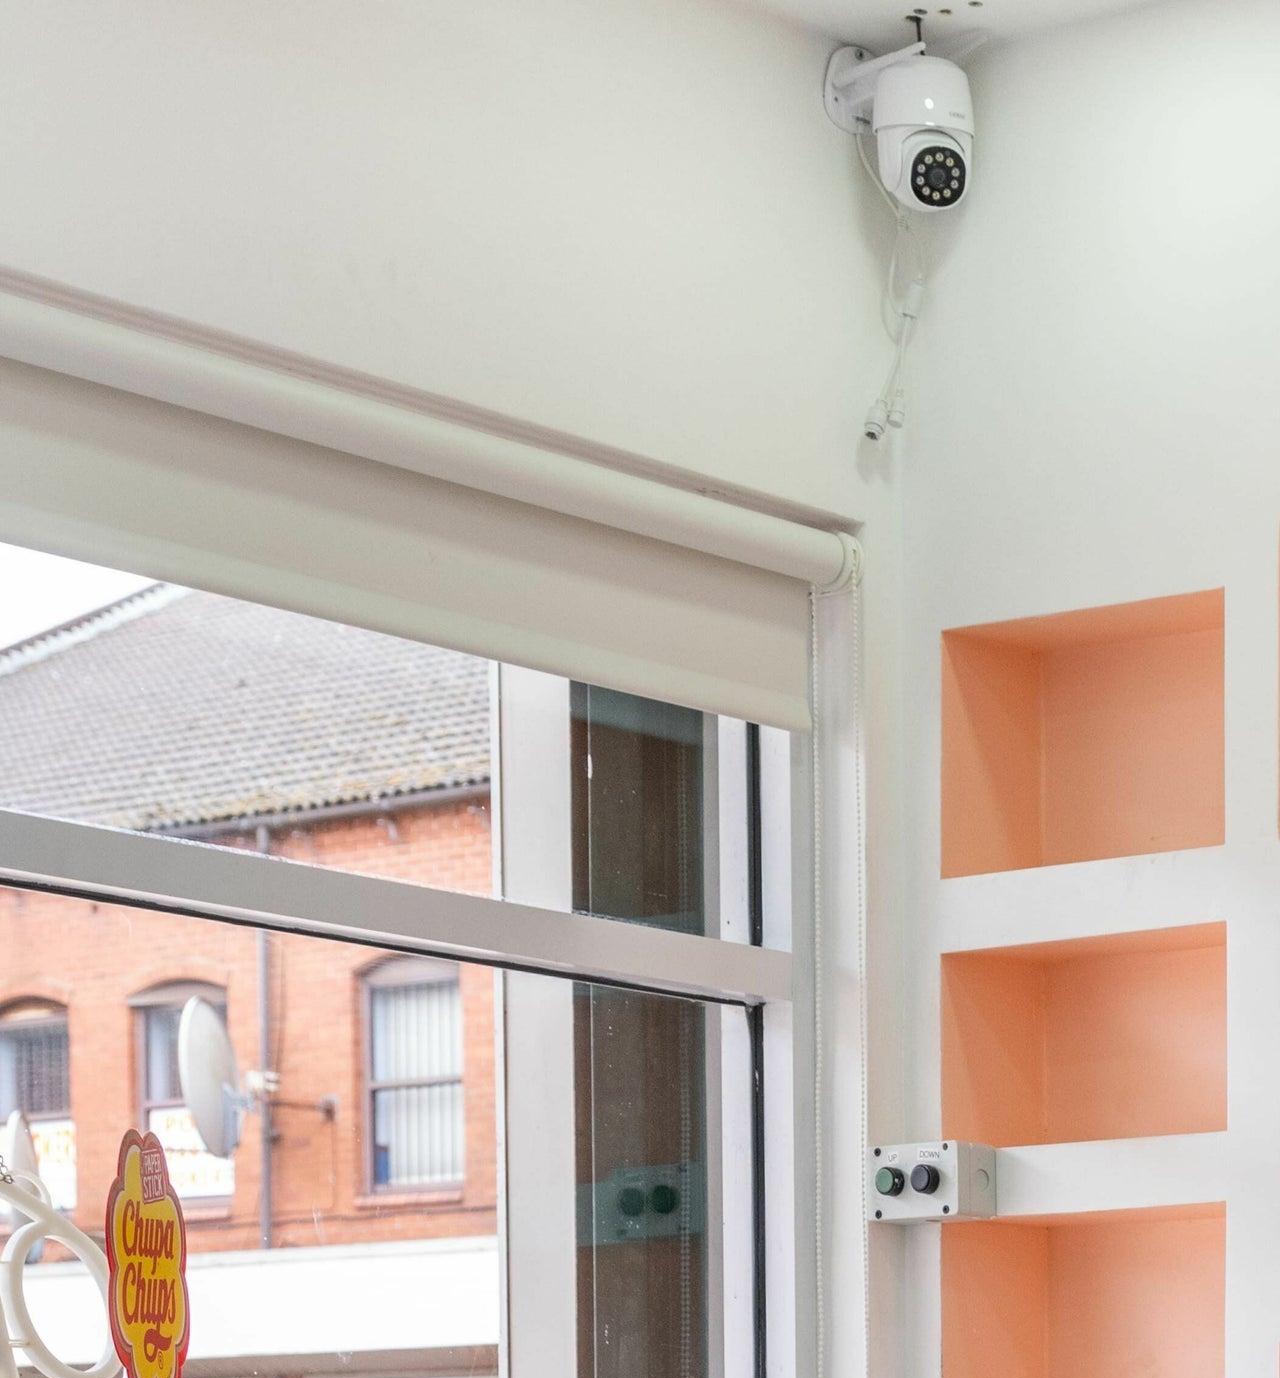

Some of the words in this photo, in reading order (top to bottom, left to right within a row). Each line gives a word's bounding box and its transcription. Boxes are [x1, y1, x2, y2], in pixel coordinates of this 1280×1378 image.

[143, 1152, 162, 1174] PAPER
[888, 1154, 898, 1163] UP
[919, 1151, 940, 1159] DOWN
[143, 1173, 164, 1198] STICK
[122, 1199, 175, 1274] Chupa
[123, 1262, 177, 1361] Chups
